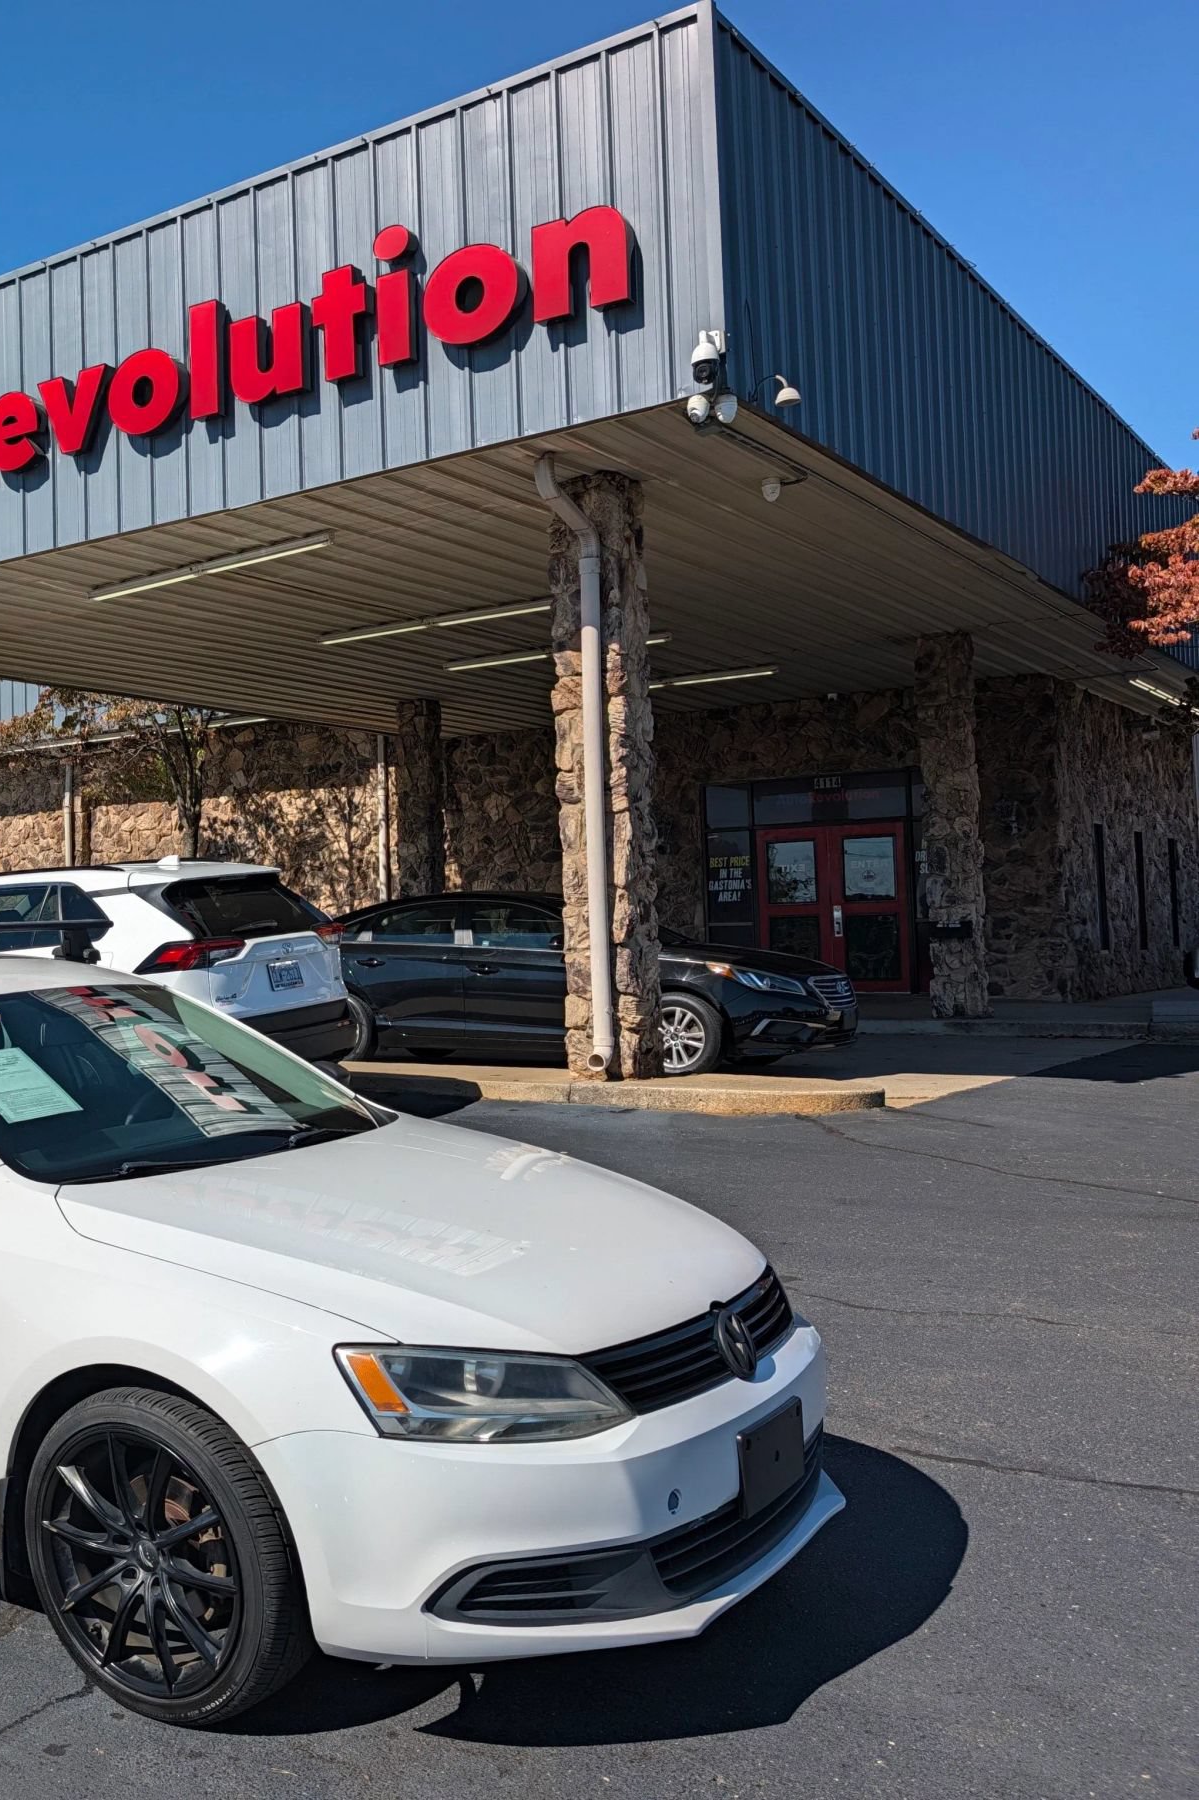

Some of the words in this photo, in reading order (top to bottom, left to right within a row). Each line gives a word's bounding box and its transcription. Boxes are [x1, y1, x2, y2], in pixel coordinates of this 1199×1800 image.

[814, 776, 841, 789] 4114
[709, 857, 729, 868] BEST
[729, 855, 751, 867] PRICE
[719, 868, 728, 879] IN
[728, 867, 743, 879] THE
[708, 878, 752, 891] GASTONIA'S
[718, 890, 742, 902] AREA!
